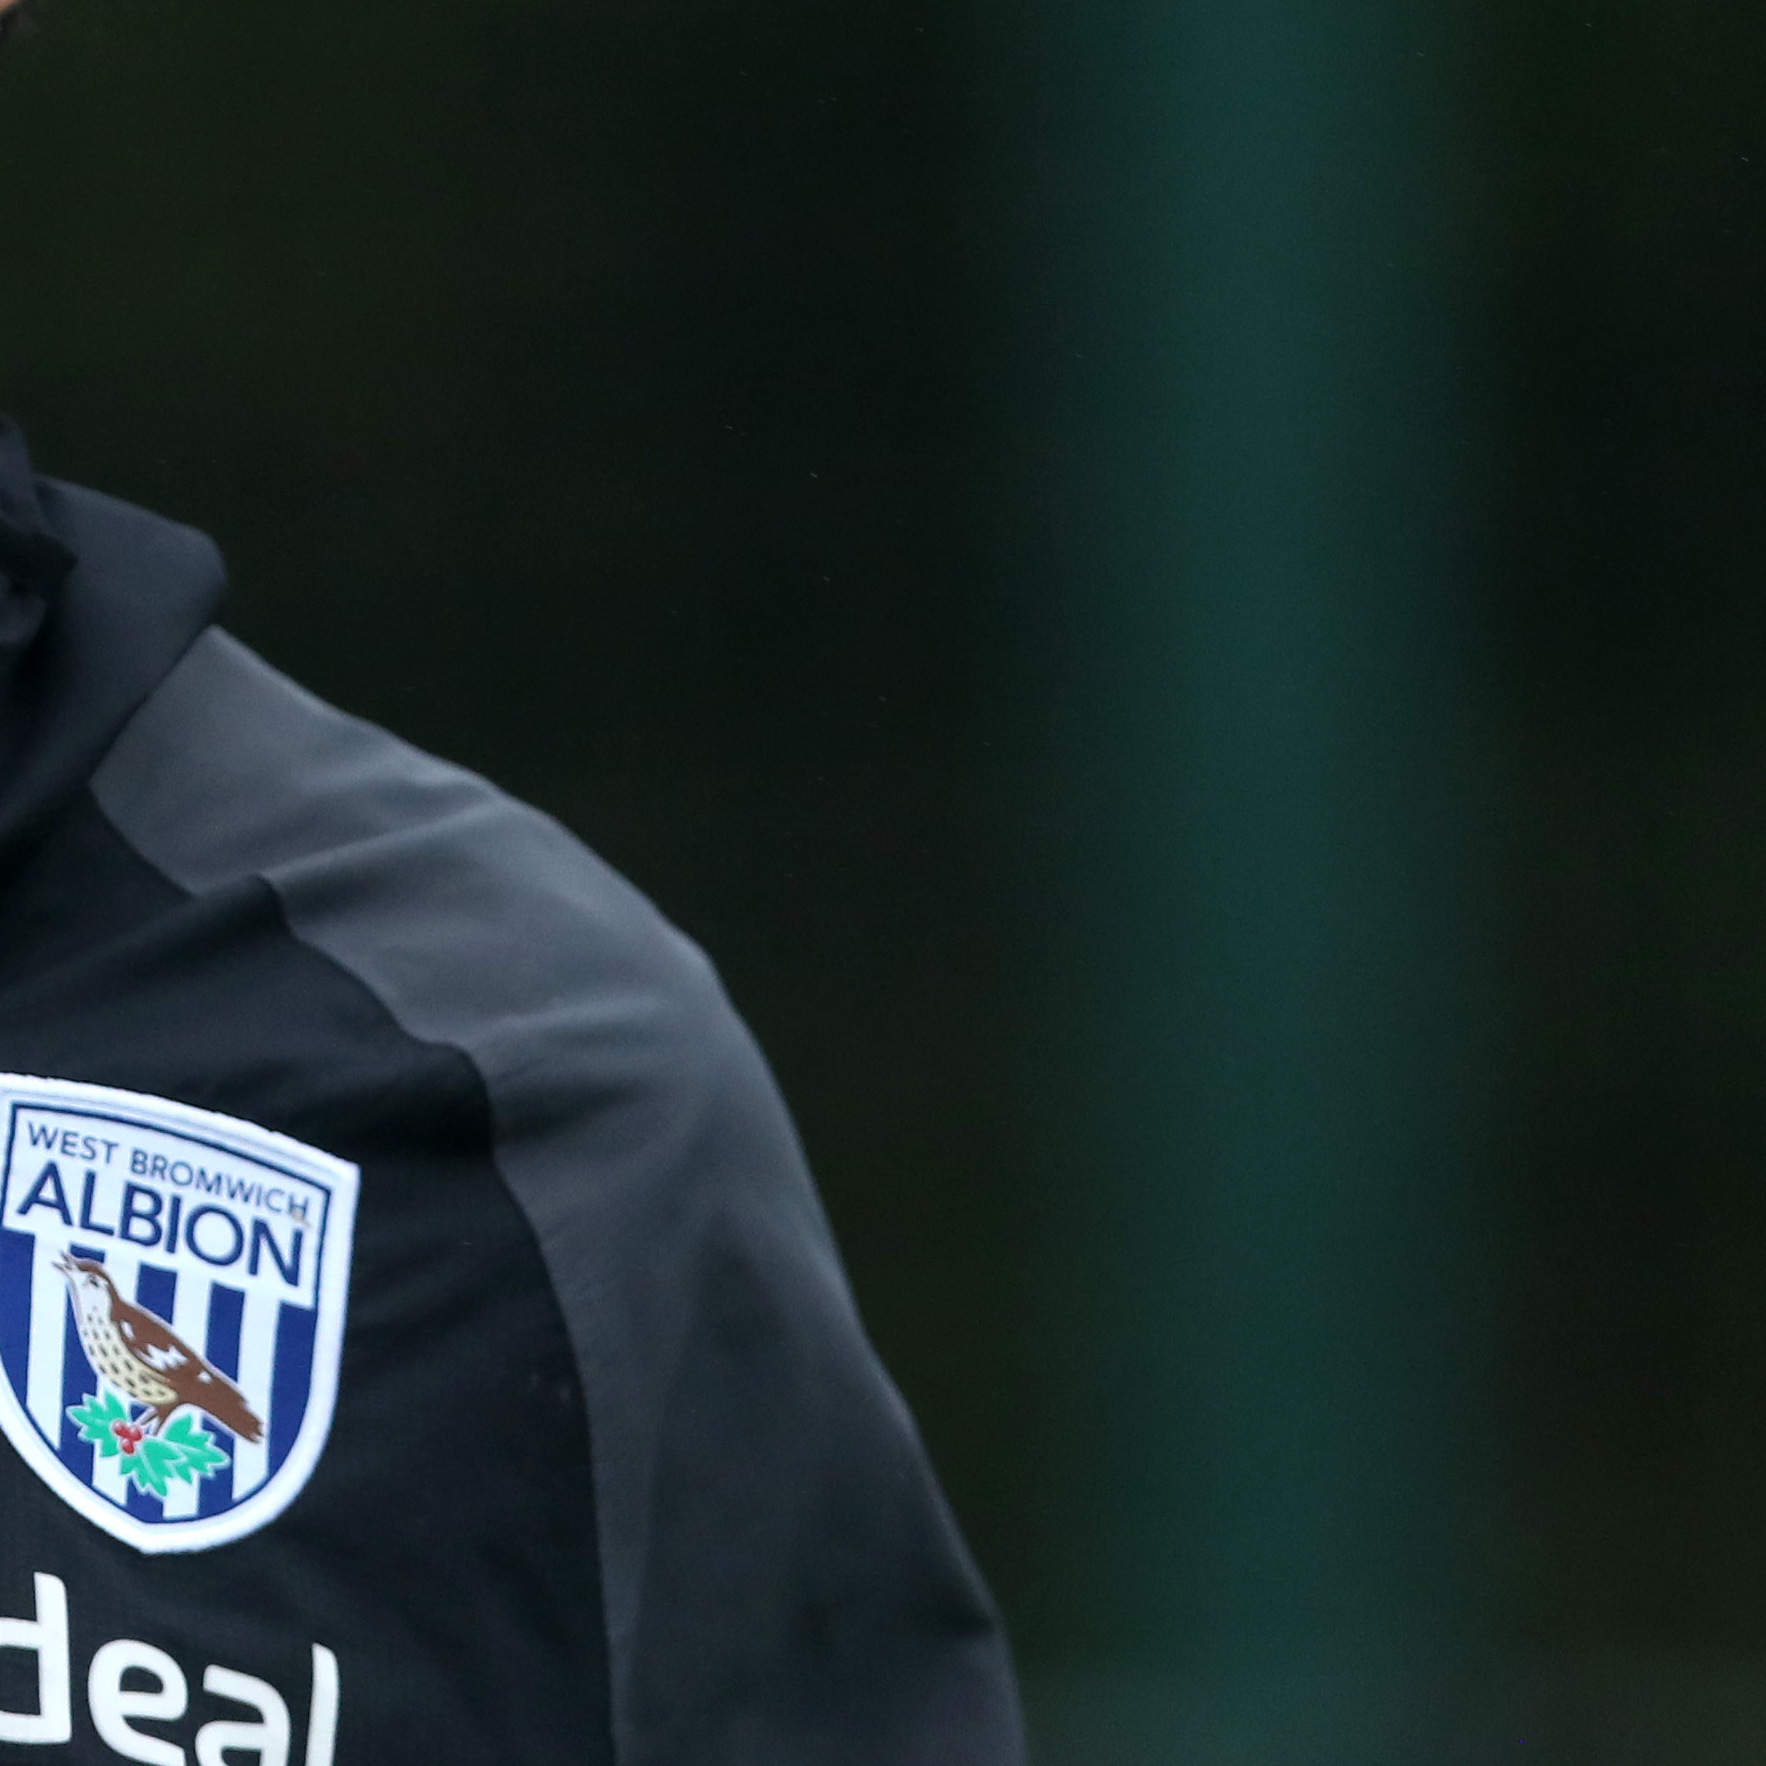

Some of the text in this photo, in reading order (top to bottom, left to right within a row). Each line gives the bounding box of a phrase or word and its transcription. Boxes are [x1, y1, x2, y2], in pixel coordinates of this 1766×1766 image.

[16, 1162, 304, 1288] ALBION
[27, 1122, 310, 1220] WEST BROMWICH
